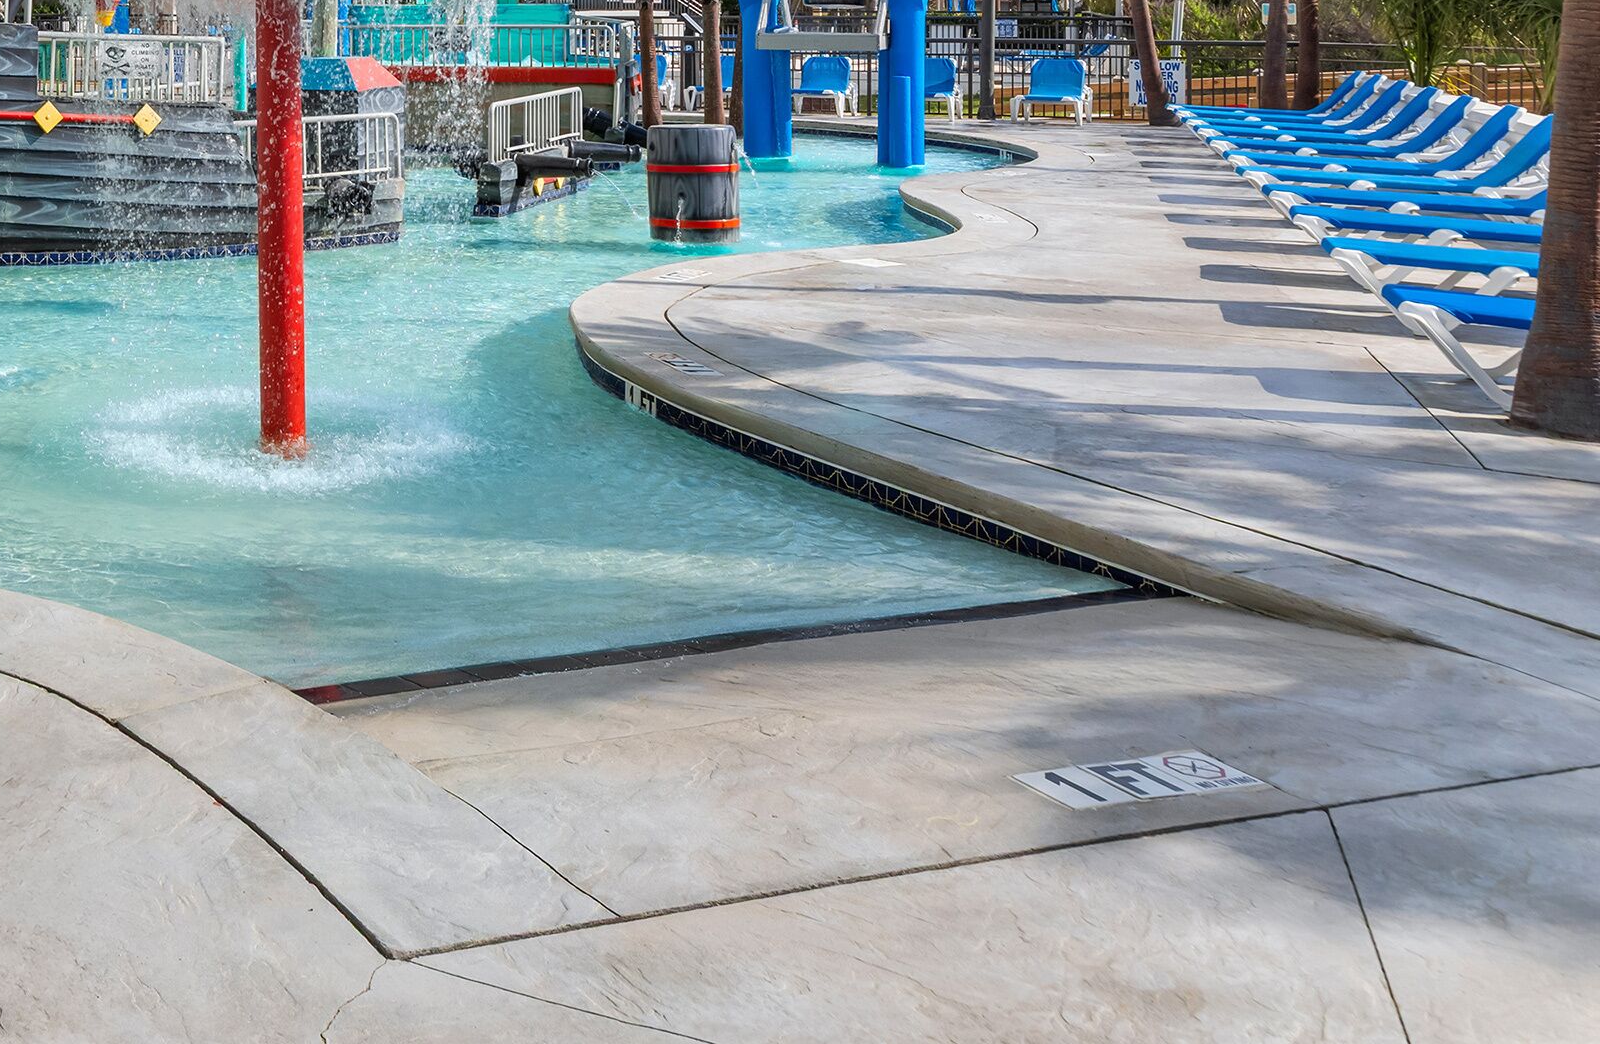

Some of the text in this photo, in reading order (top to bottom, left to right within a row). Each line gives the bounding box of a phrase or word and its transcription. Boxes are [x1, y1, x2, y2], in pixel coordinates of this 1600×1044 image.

[1133, 61, 1181, 71] SLOW
[1044, 761, 1184, 802] 1 FT
